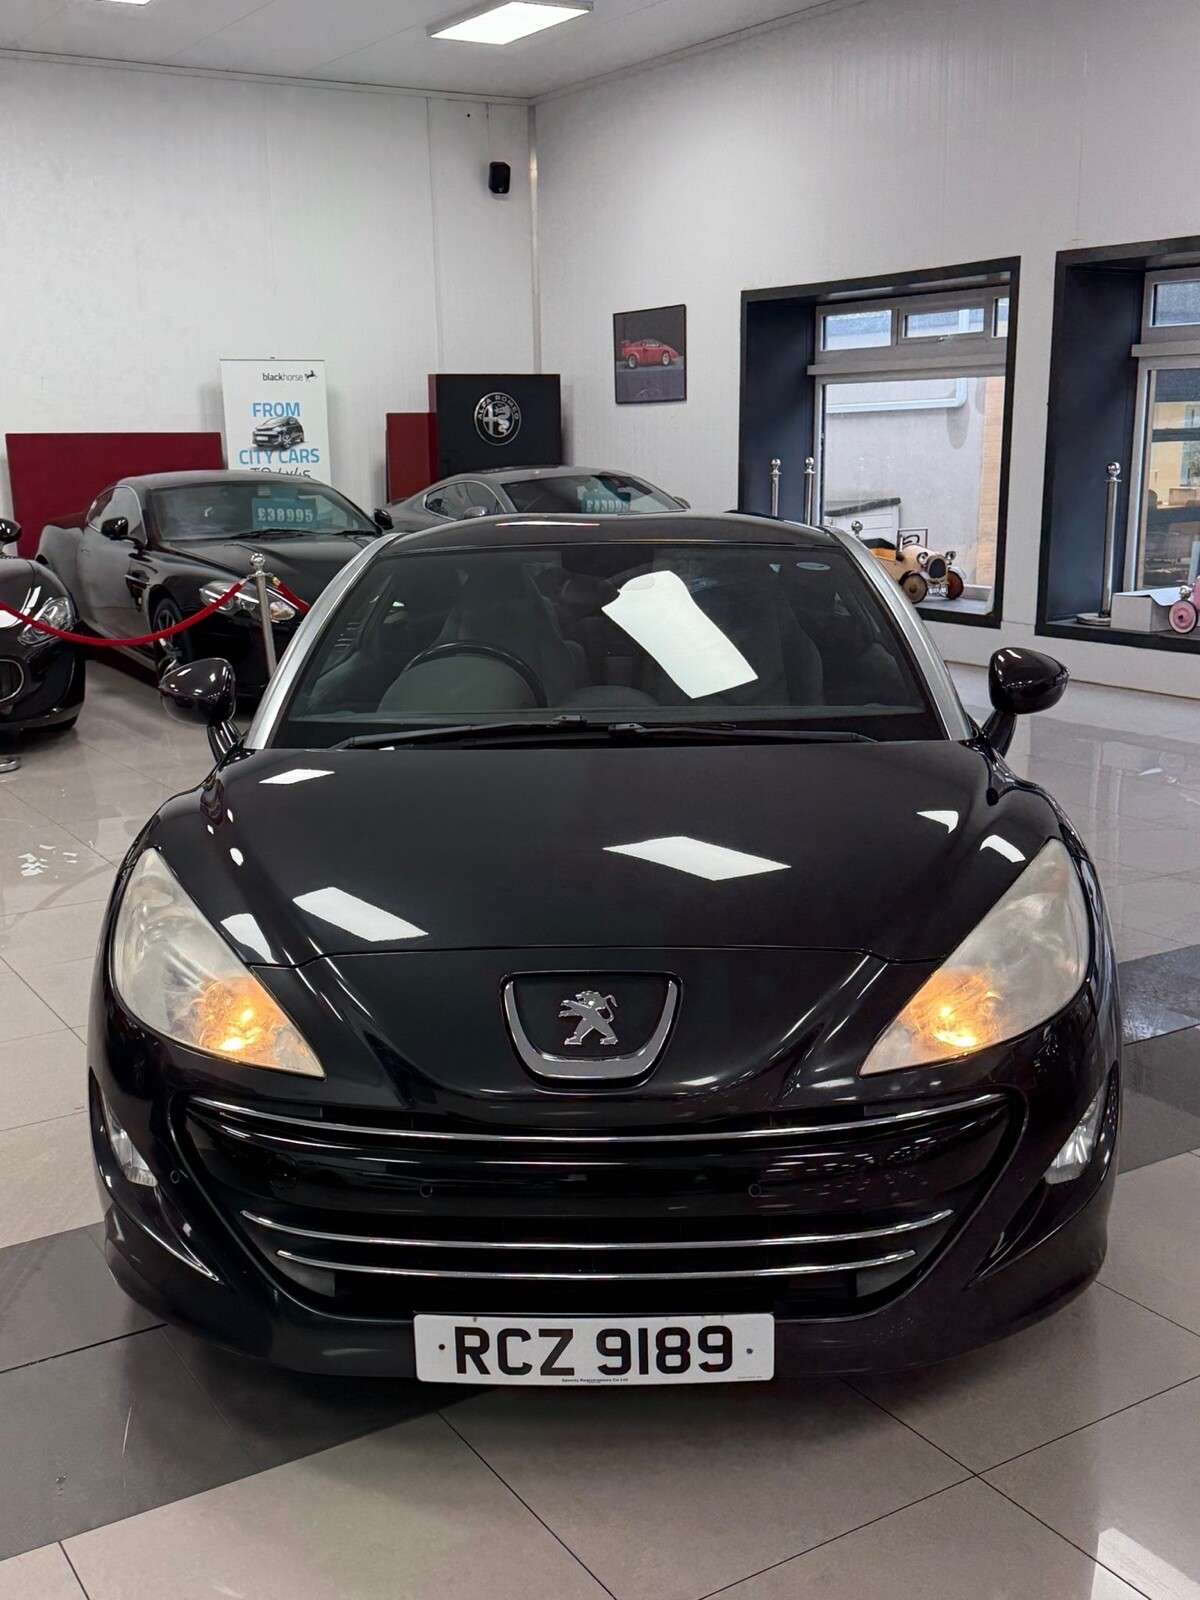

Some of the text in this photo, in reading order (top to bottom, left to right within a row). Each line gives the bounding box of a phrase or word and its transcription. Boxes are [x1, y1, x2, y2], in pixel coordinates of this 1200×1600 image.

[262, 372, 304, 382] blackhorse
[252, 402, 301, 418] FROM
[239, 447, 321, 465] CITY CARS
[454, 1324, 733, 1377] RCZ 9189
